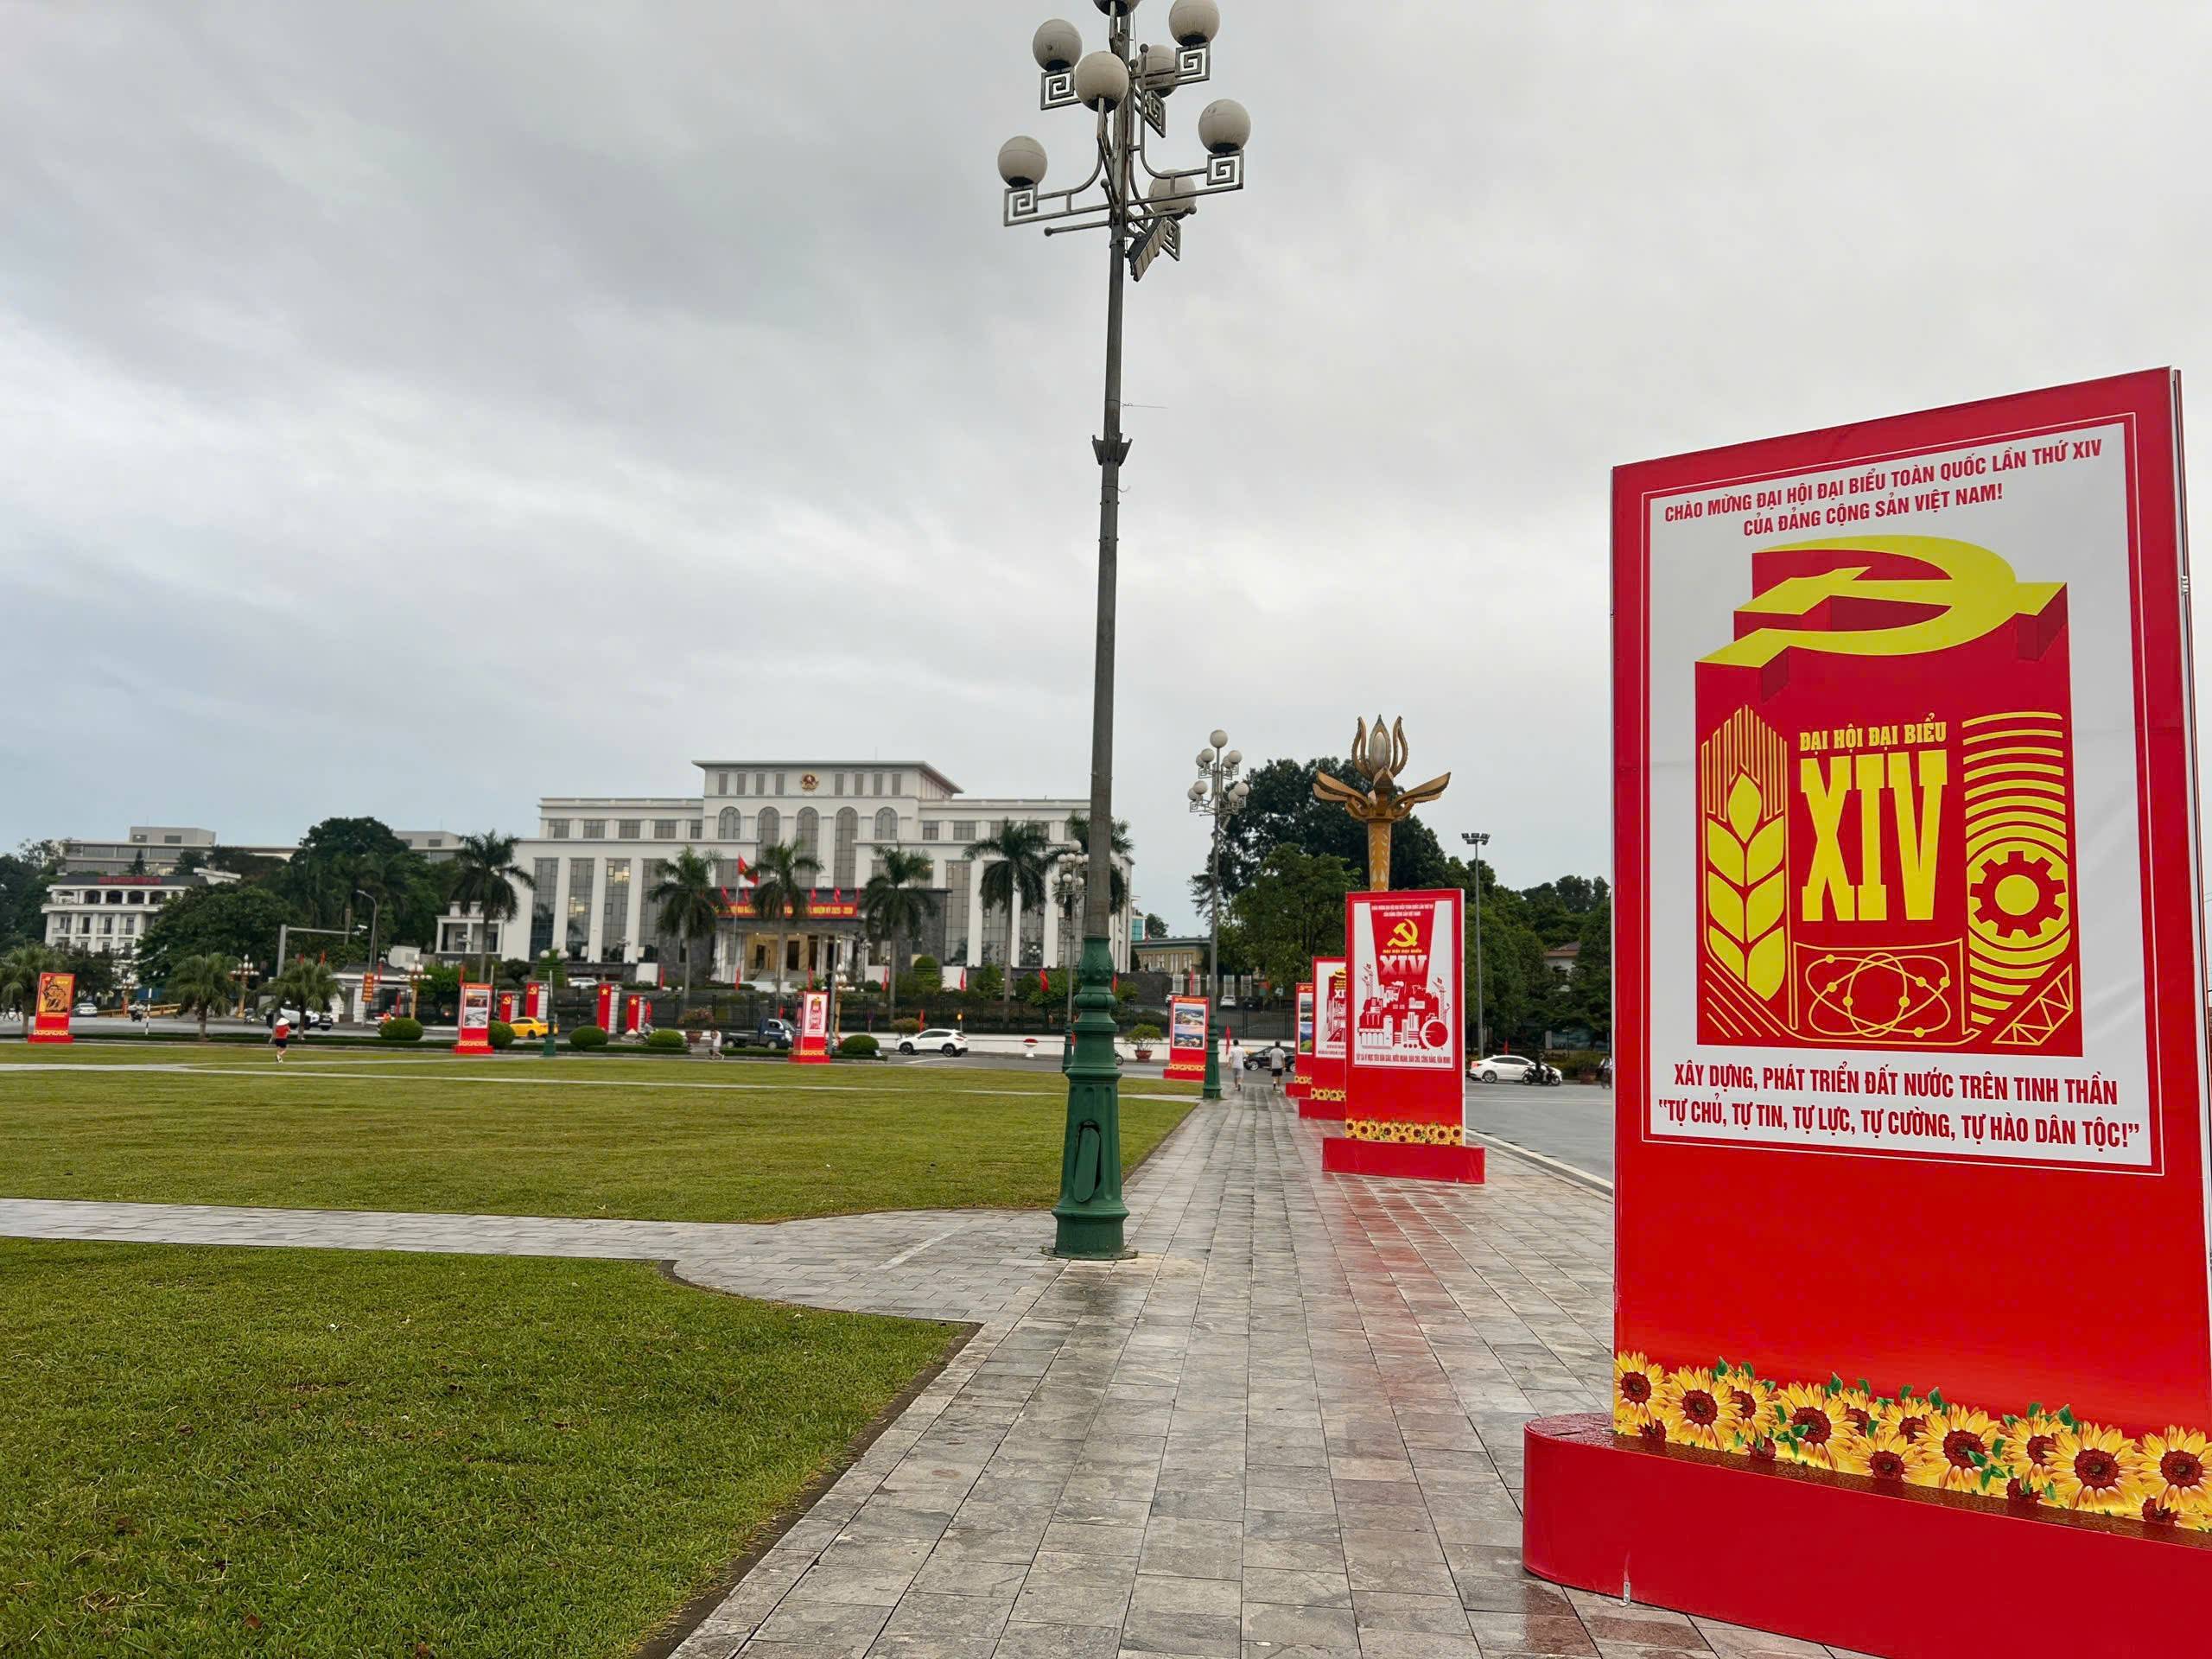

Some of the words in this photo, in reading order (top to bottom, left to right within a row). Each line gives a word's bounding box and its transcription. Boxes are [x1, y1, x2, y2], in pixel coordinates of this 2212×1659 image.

[1665, 499, 1702, 521] CHÀO
[1707, 493, 1751, 515] MỪNG
[1757, 490, 1782, 510] ĐẠI
[1787, 483, 1813, 505] HỘI
[1817, 480, 1843, 500] ĐẠI
[1849, 468, 1885, 493] BIỂU
[1891, 465, 1935, 486] TOÀN
[1941, 453, 1986, 481] QUỐC
[1993, 447, 2026, 472] LẦN
[2032, 440, 2069, 465] THỨ
[2073, 439, 2101, 460] XIV
[1744, 512, 1774, 536] CỦA
[1778, 507, 1821, 531] ĐẢNG
[1827, 503, 1870, 526] CỘNG
[1875, 492, 1910, 517] SẢN
[1915, 489, 1950, 512] VIỆT
[1956, 483, 2003, 506] NAM!
[1800, 730, 1828, 755] ĐẠI
[1834, 723, 1863, 753] HỘI
[1868, 726, 1898, 751] ĐẠI
[1904, 712, 1947, 744] BIỂU
[1800, 749, 1948, 921] XIV
[1380, 955, 1427, 975] XIV
[1675, 1059, 1704, 1086] XÂY
[1709, 1064, 1758, 1092] DỰNG,
[1763, 1064, 1805, 1090] PHÁT
[1810, 1061, 1859, 1093] TRIỂN
[1865, 1065, 1898, 1096] ĐẤT
[1904, 1067, 1954, 1098] NƯỚC
[1960, 1071, 2008, 1101] TRÊN
[2013, 1077, 2058, 1103] TINH
[2064, 1071, 2118, 1105] THẦN
[1691, 1092, 1726, 1127] CHỦ,
[1732, 1101, 1753, 1130] TỰ
[1757, 1104, 1787, 1131] TIN,
[1793, 1104, 1815, 1135] TỰ
[1818, 1106, 1855, 1135] LỰC,
[1861, 1108, 1885, 1139] TỰ
[1888, 1106, 1955, 1141] CƯỜNG,
[1961, 1113, 1986, 1145] TỰ
[1990, 1112, 2029, 1141] HÀO
[2035, 1114, 2076, 1145] DÂN
